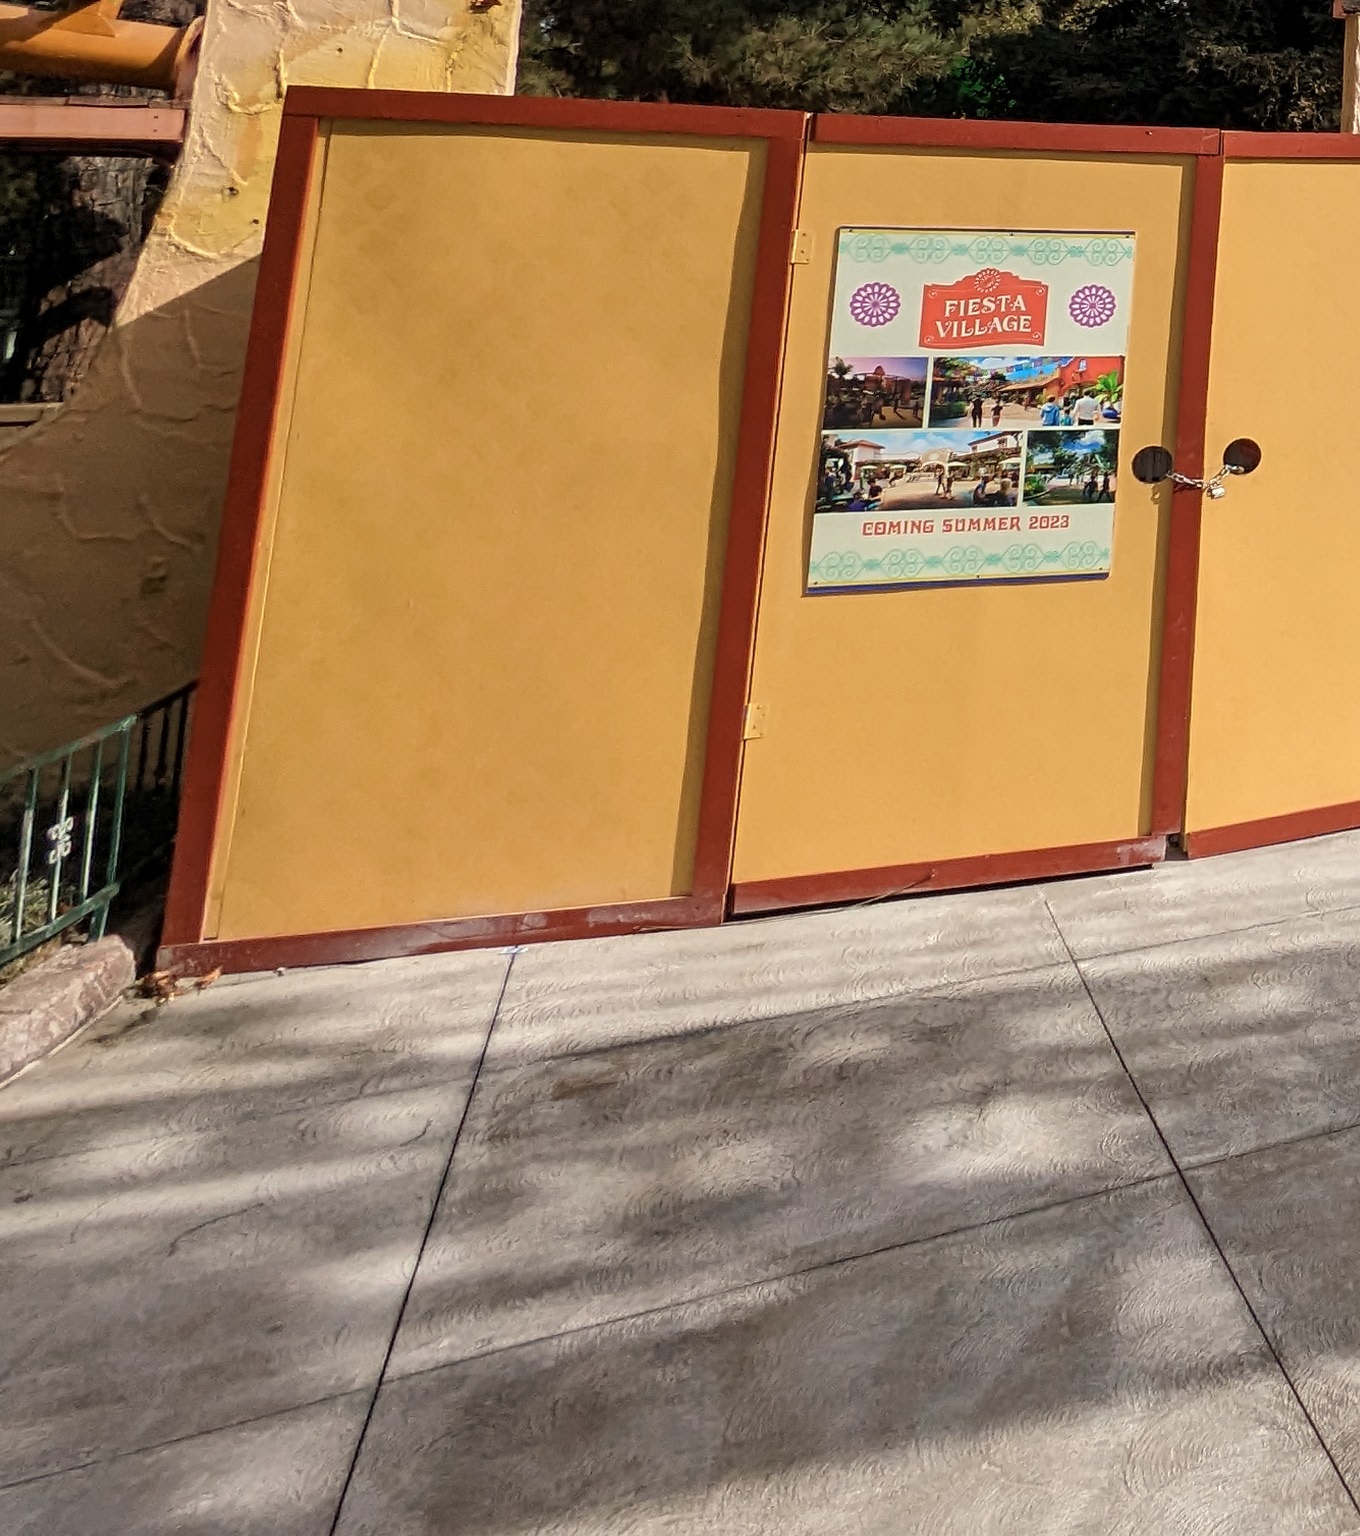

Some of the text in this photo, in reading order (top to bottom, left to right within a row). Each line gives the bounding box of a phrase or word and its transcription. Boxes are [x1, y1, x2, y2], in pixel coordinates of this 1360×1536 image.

[944, 295, 1027, 317] FIESTA
[935, 314, 1032, 339] VILLAGE
[862, 514, 1070, 536] COMING SUMMER 2023
